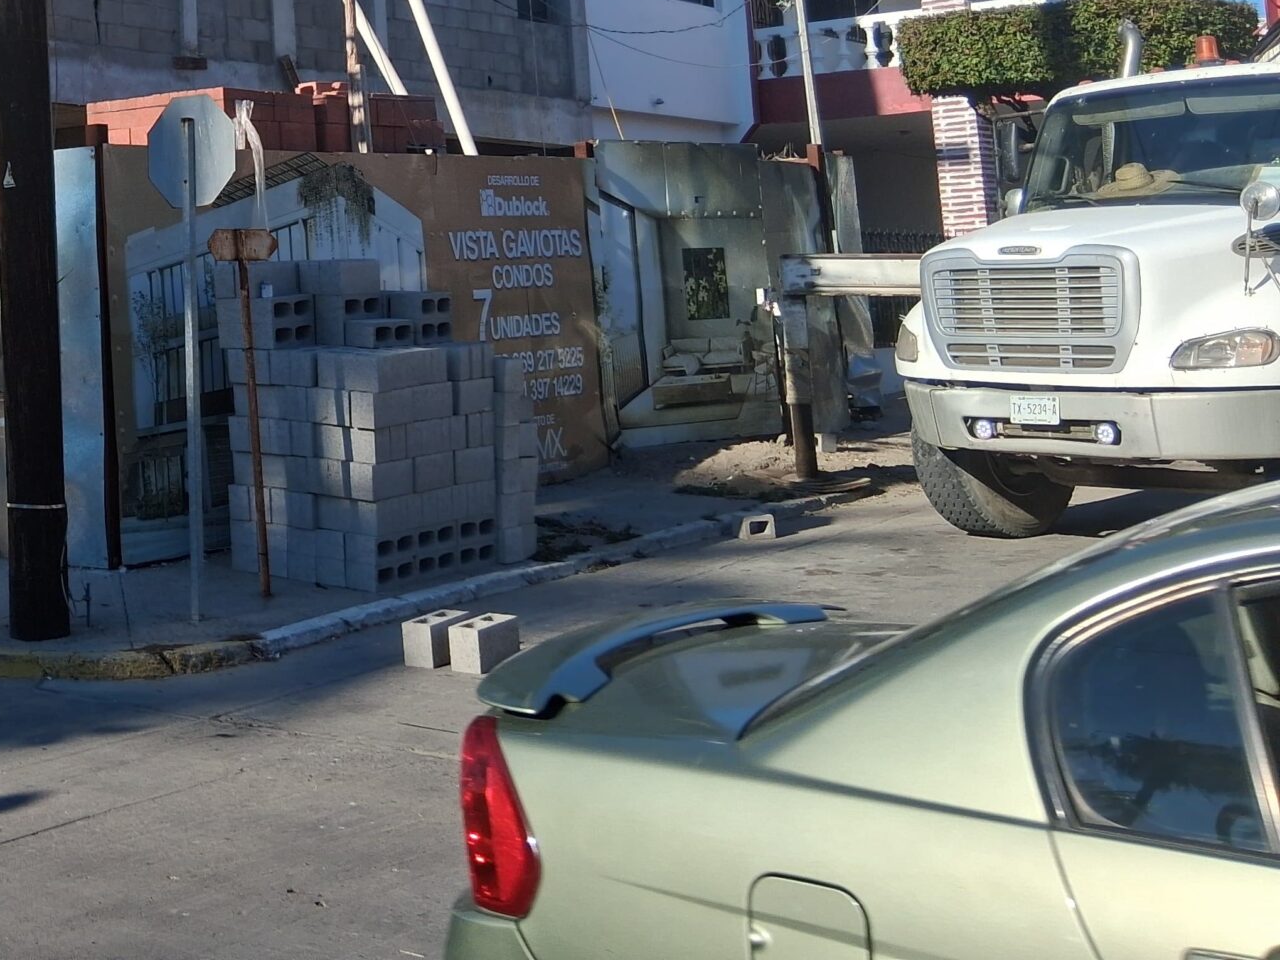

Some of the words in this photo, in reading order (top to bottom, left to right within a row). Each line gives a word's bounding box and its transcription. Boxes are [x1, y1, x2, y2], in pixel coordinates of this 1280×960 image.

[488, 175, 529, 186] DESARROLLO
[530, 175, 540, 186] DE
[449, 231, 499, 260] VISTA
[503, 229, 581, 259] GAVIOTAS
[492, 263, 553, 289] CONDOS
[473, 289, 492, 341] 7
[491, 312, 560, 340] UNIDADES
[537, 349, 554, 371] 217
[557, 346, 584, 369] 5225
[530, 378, 550, 400] 397
[553, 374, 583, 397] 14229
